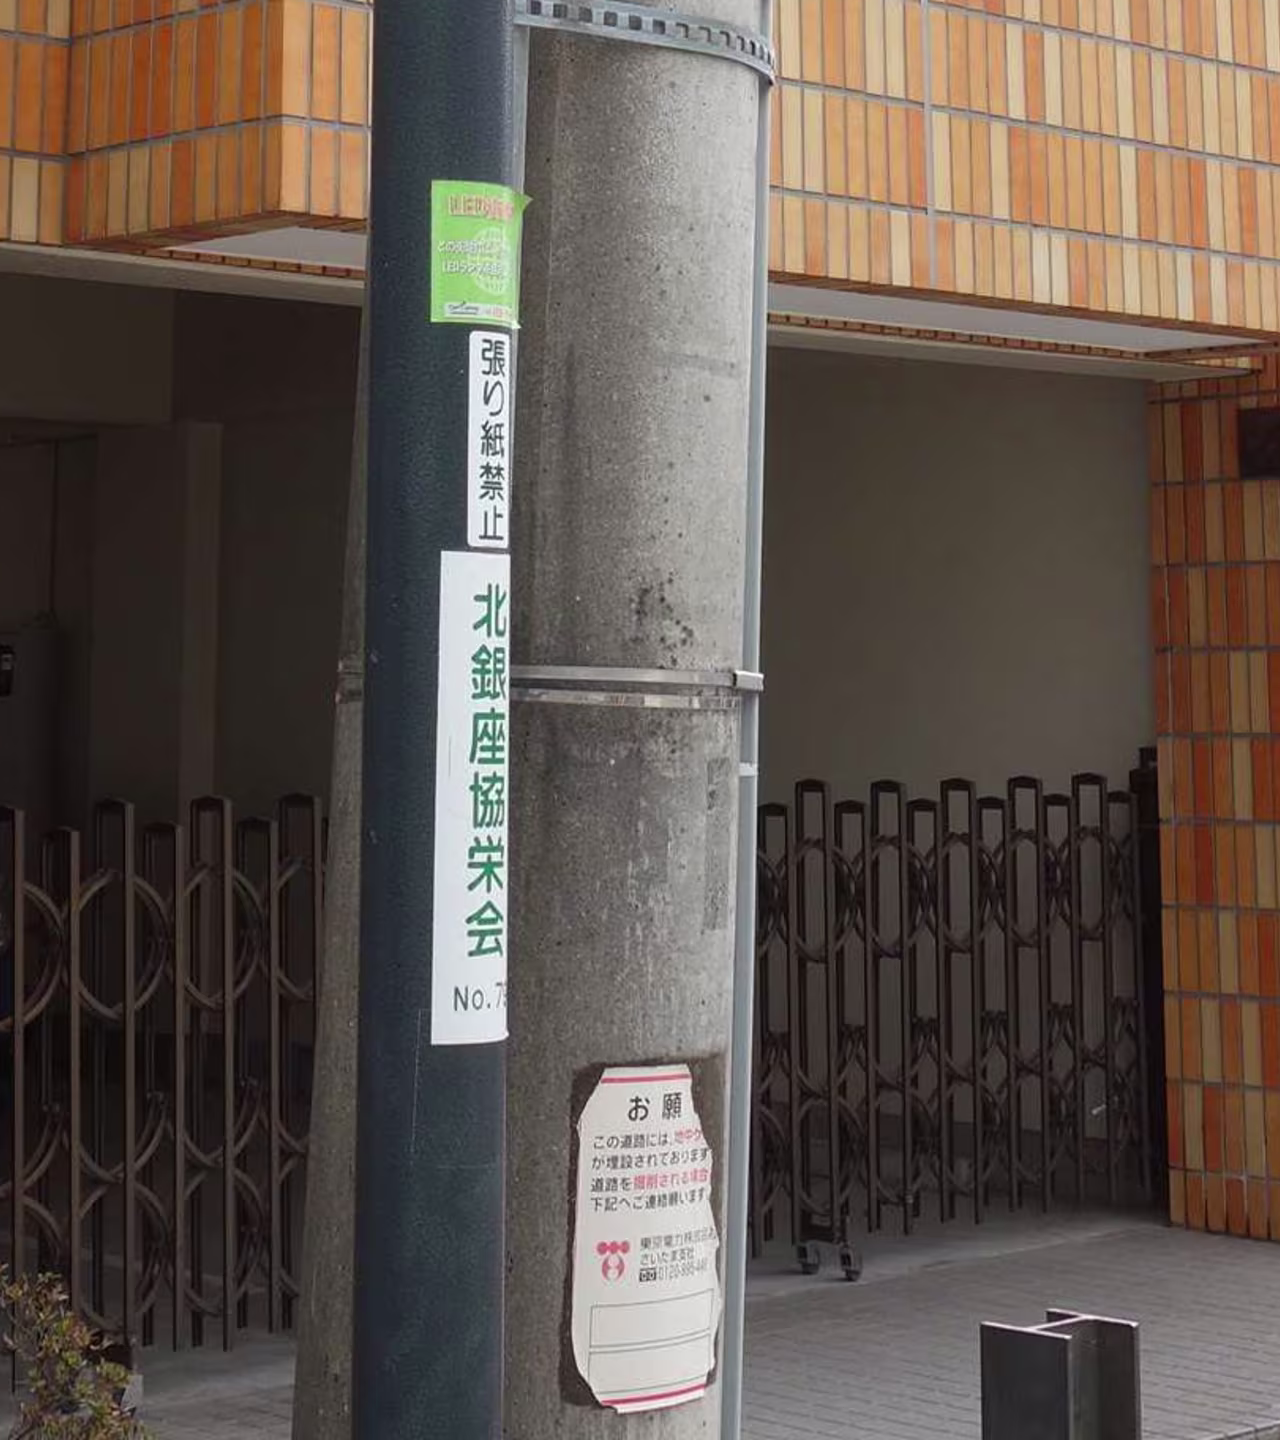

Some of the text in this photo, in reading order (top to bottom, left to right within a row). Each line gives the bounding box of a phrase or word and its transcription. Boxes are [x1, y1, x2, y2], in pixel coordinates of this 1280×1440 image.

[478, 337, 506, 542] 張り紙禁止
[464, 581, 508, 958] 北銀座協栄会
